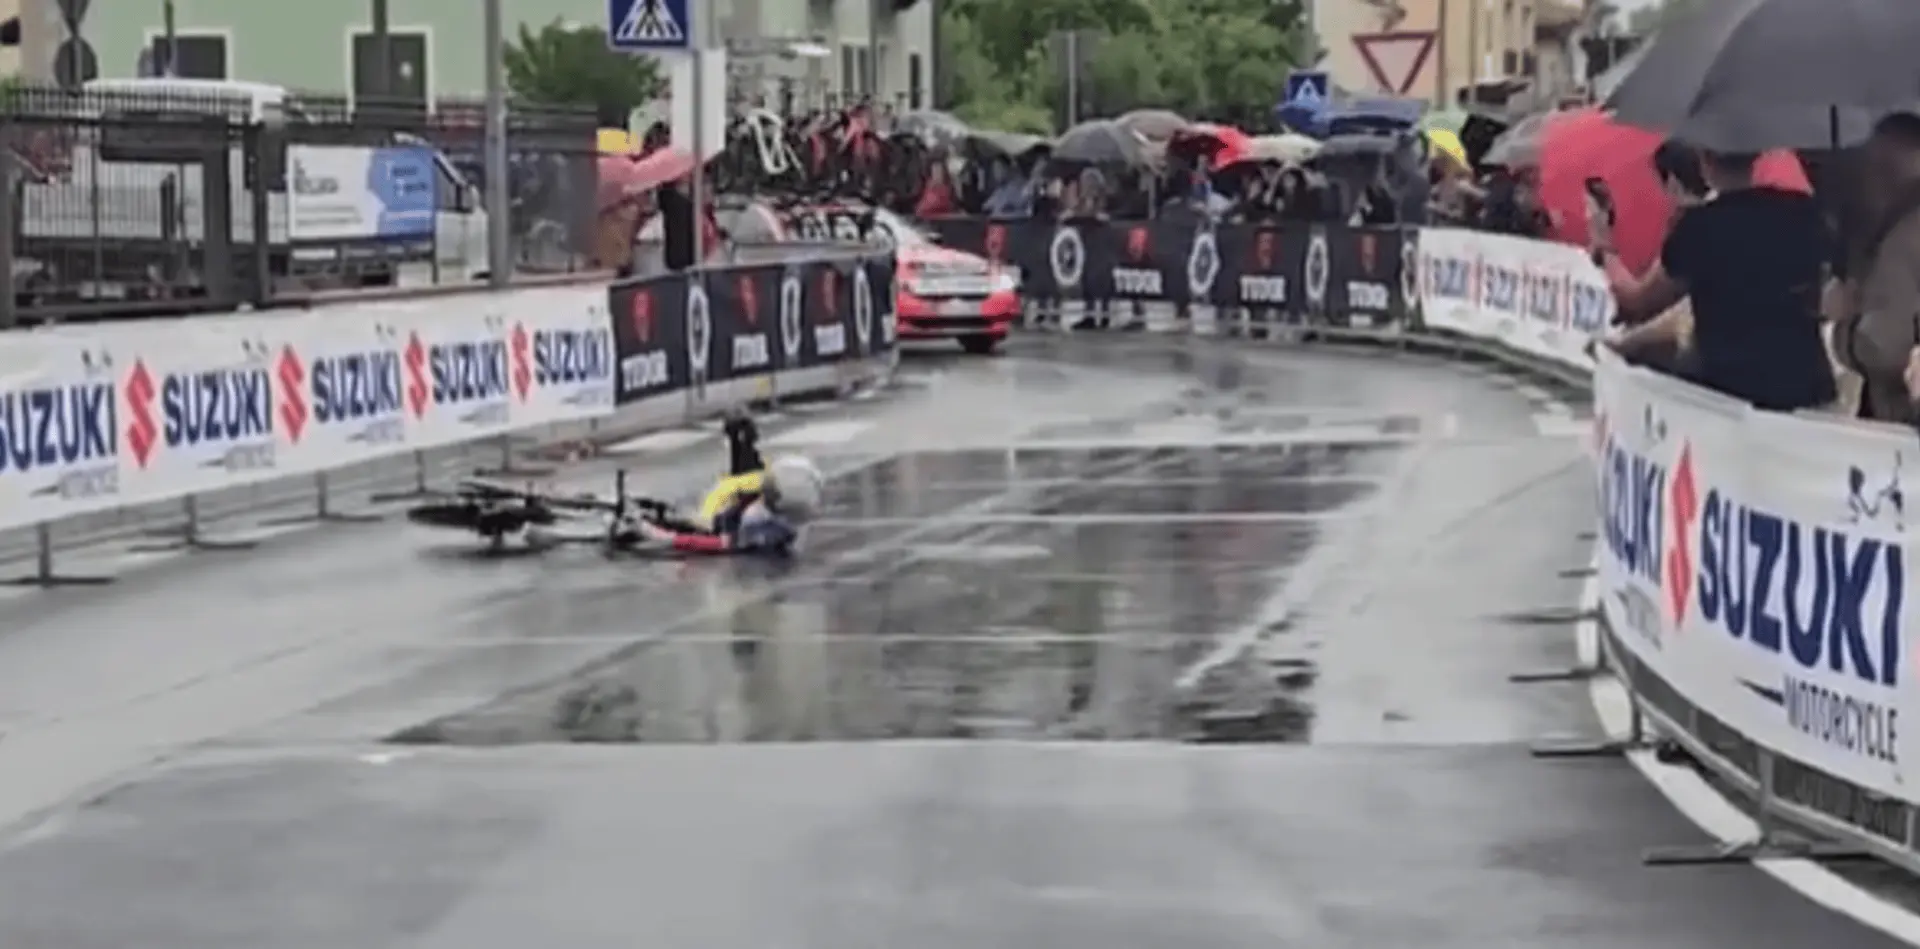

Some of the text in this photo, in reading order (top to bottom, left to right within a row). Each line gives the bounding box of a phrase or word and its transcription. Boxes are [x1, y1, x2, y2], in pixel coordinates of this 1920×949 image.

[163, 370, 272, 448] SUZUKI
[312, 352, 402, 423] SUZUKI
[430, 340, 509, 405] SUZUKI
[0, 383, 117, 472] UZUKI
[1698, 486, 1903, 687] SUZUKI
[1784, 672, 1898, 764] MOTORCYCLE
